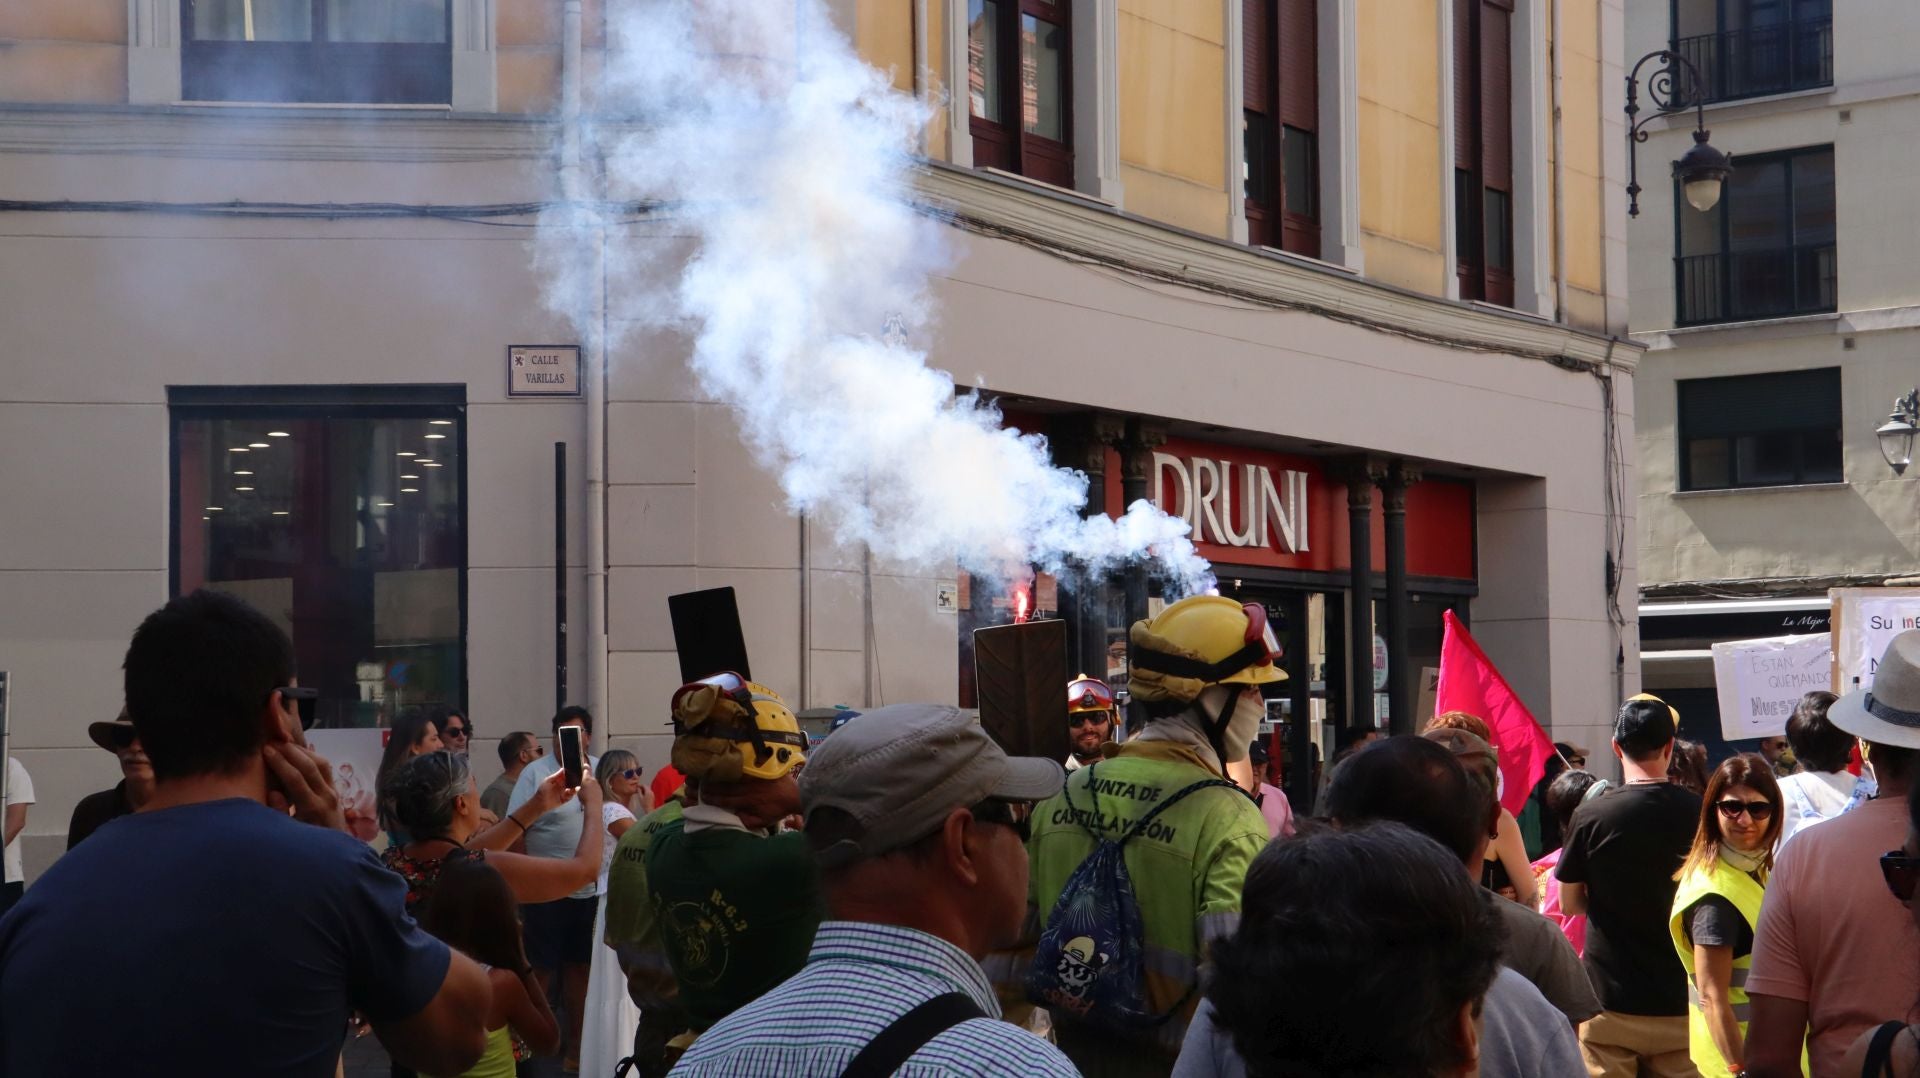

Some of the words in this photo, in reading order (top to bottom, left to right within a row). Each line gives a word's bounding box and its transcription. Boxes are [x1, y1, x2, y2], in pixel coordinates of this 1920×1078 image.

[531, 355, 559, 365] CALLE
[525, 373, 565, 384] VARILLAS
[1152, 451, 1310, 554] DRUNI
[1871, 615, 1893, 630] Su
[1751, 697, 1801, 716] NUEST
[1082, 778, 1136, 800] JUNTA
[1139, 786, 1162, 802] DE
